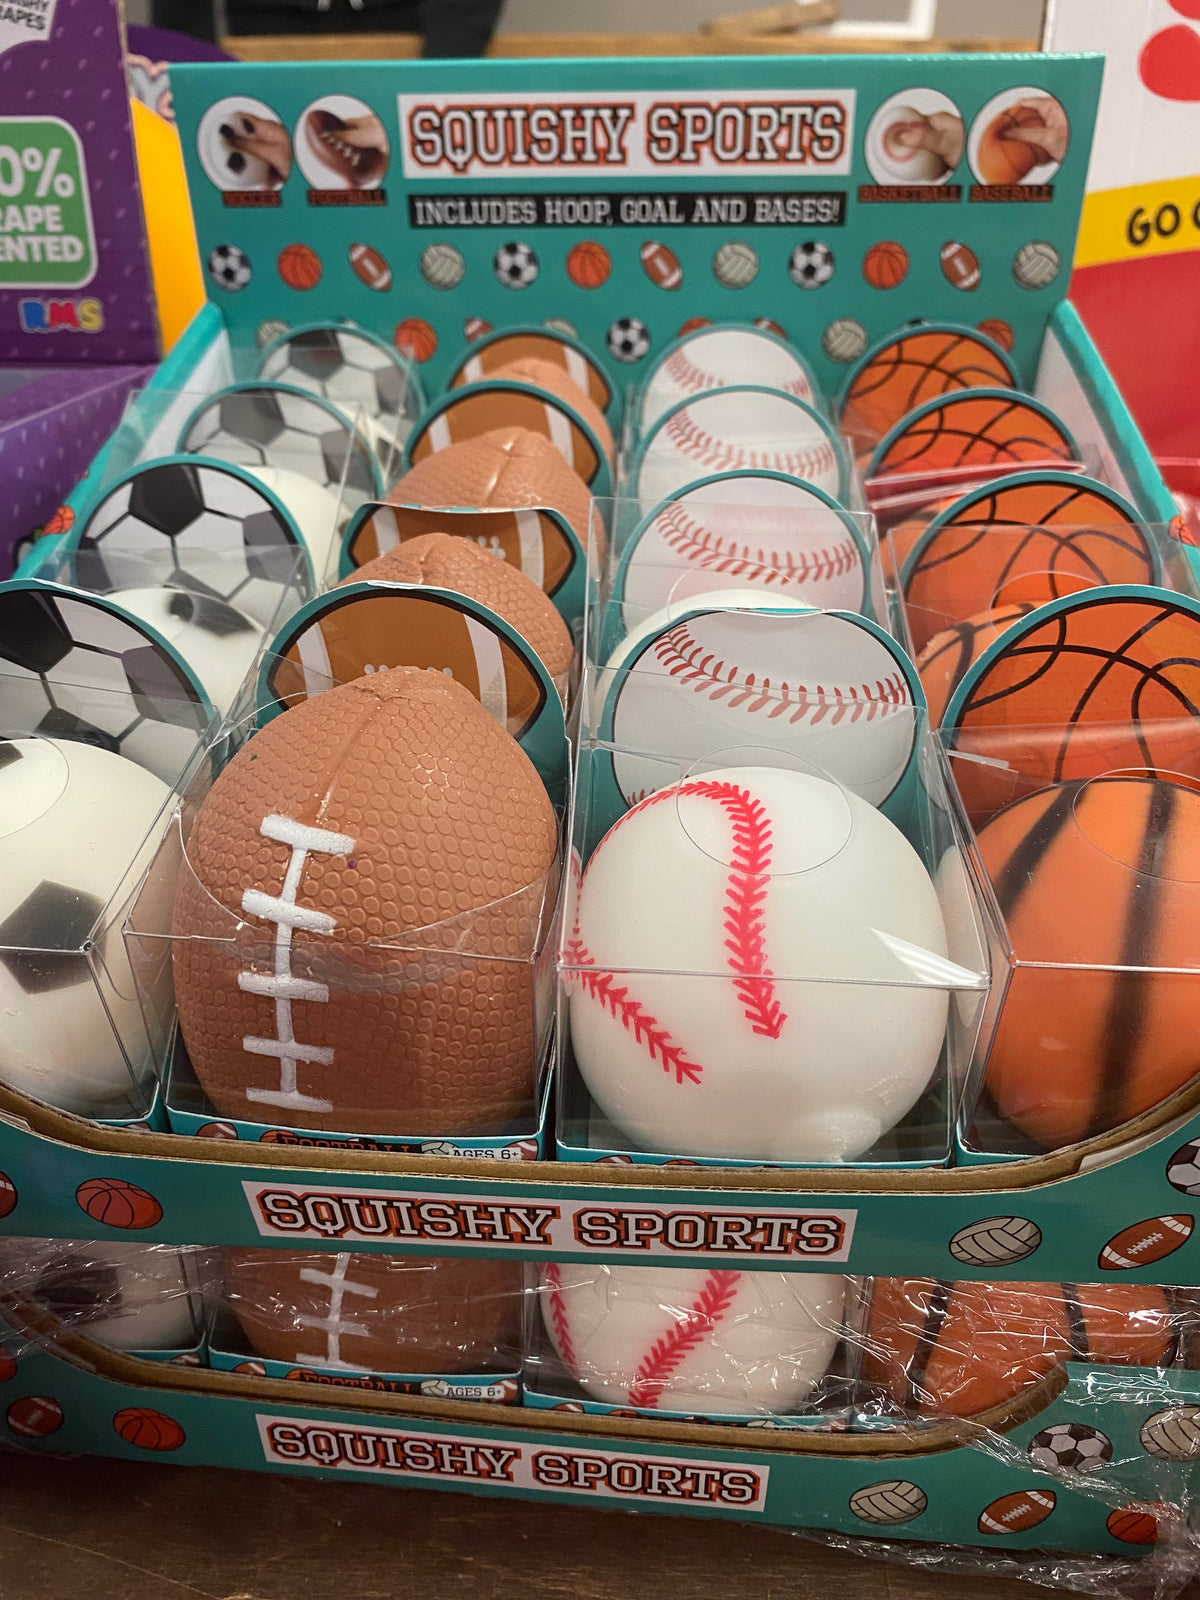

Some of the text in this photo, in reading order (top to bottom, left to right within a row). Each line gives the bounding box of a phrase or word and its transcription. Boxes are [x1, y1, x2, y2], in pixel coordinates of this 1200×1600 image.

[0, 5, 46, 30] APES
[409, 100, 848, 174] SQUISHY SPORTS
[0, 204, 64, 232] APE
[414, 198, 841, 226] INCLUDES HOOP, GOAL AND BASES!
[1126, 204, 1181, 248] GO
[20, 298, 104, 333] RMS
[453, 1149, 519, 1160] AGES 6+
[256, 1189, 847, 1256] SQUISHY SPORTS
[446, 1387, 502, 1397] AGES 6+
[266, 1422, 761, 1505] SQUISHY SPORTS
